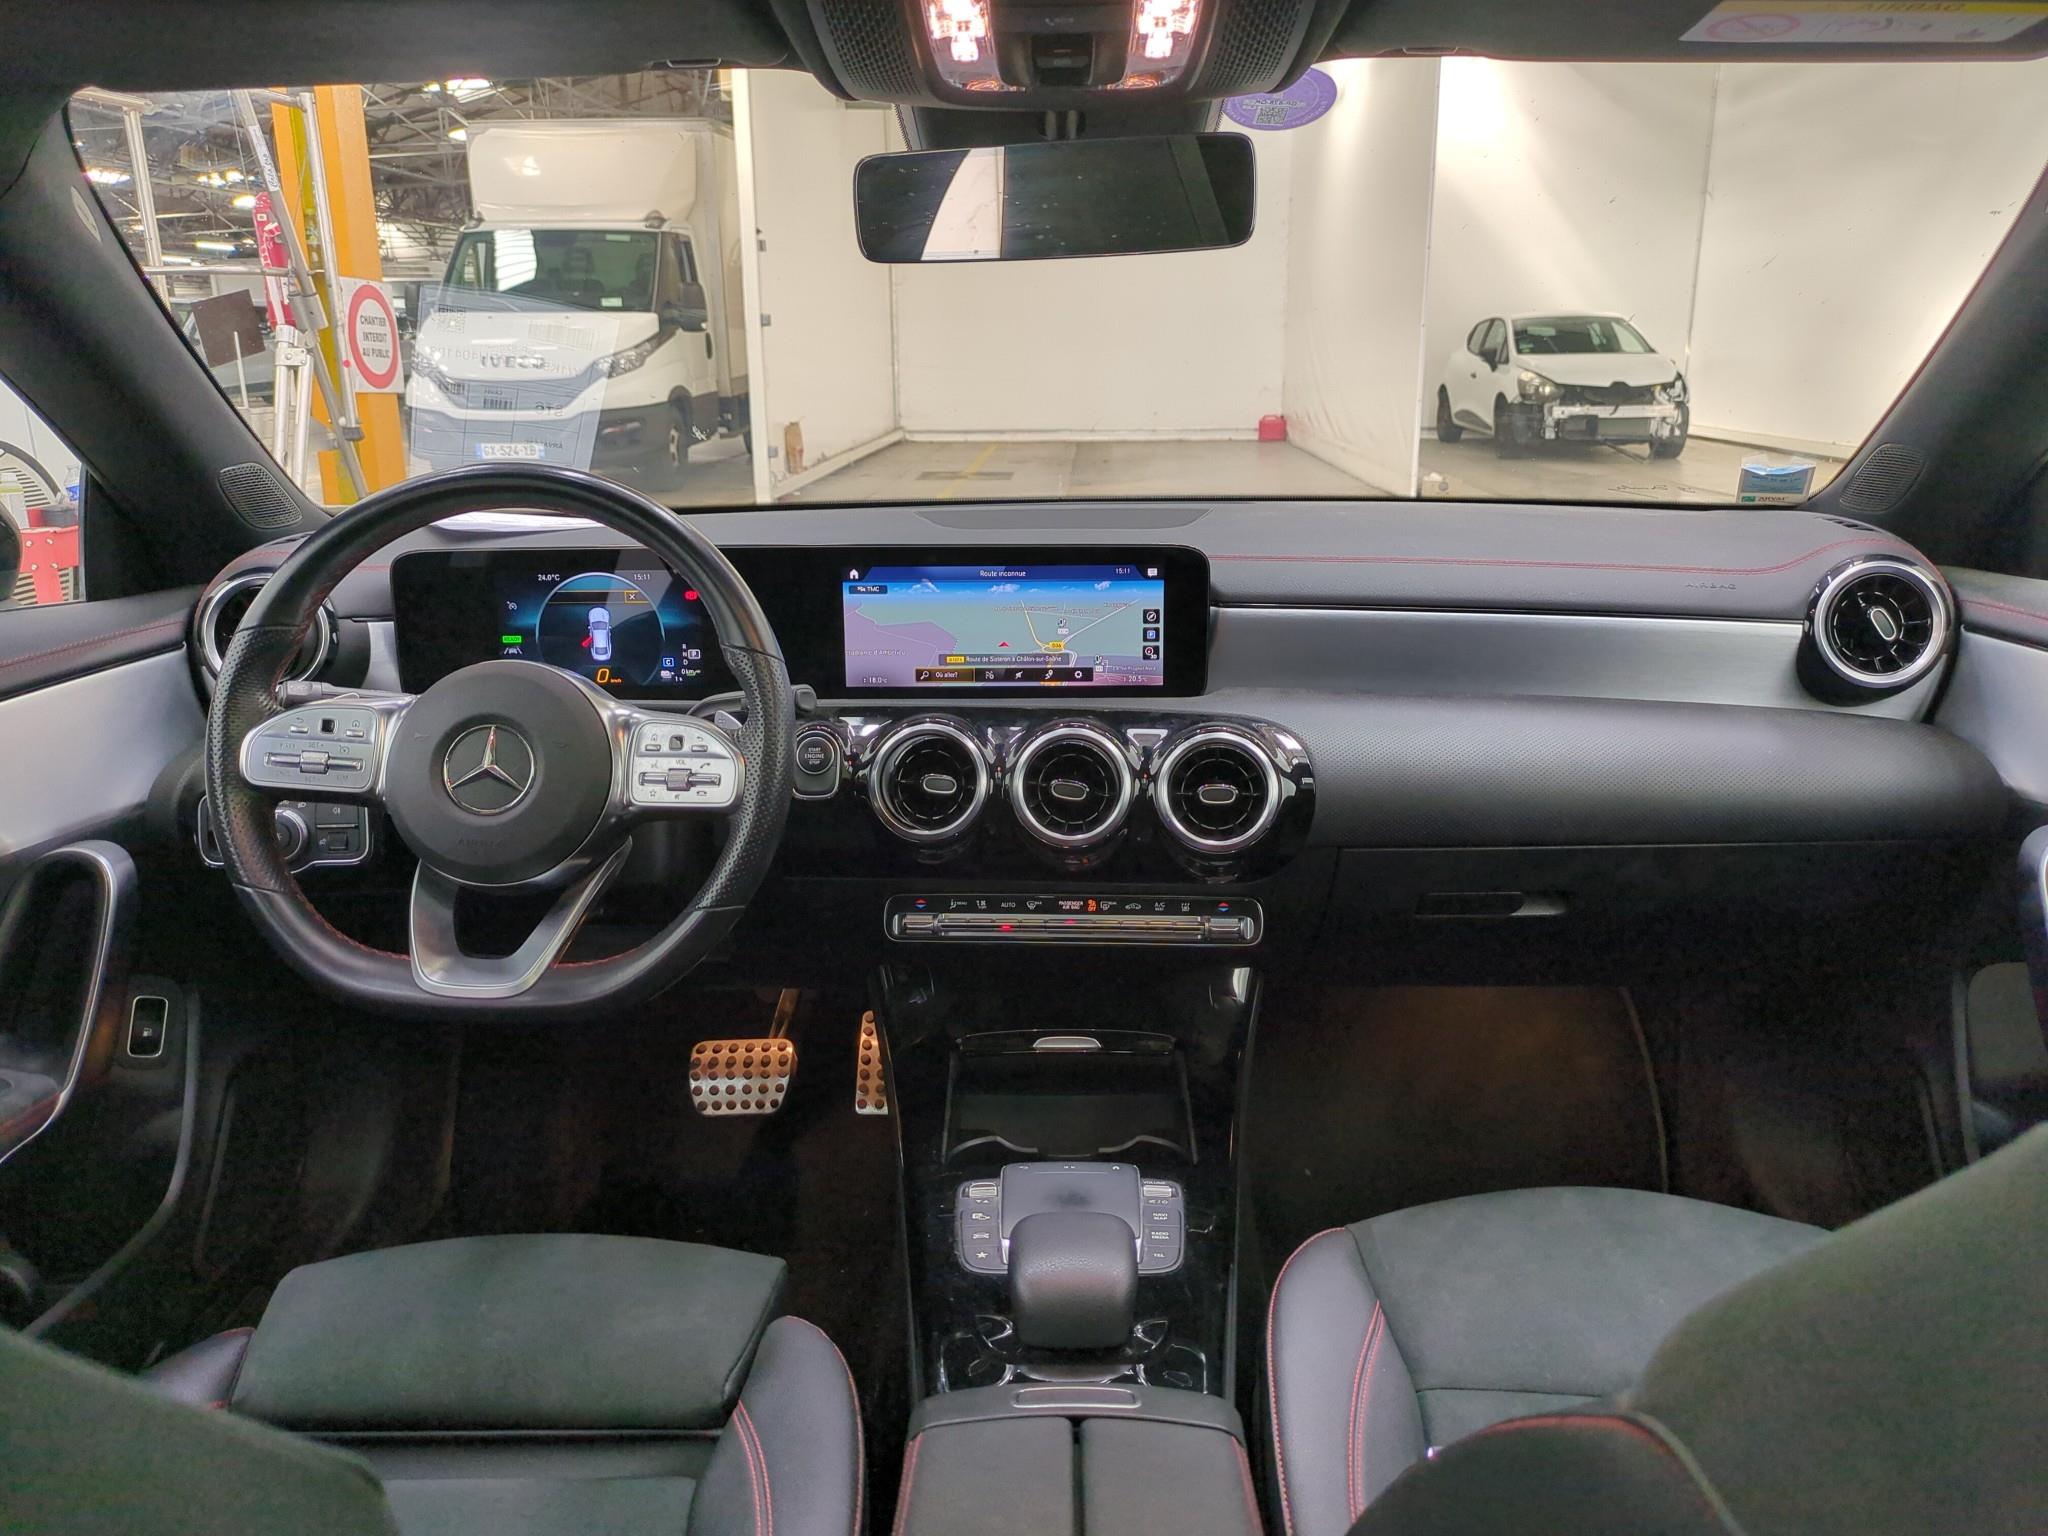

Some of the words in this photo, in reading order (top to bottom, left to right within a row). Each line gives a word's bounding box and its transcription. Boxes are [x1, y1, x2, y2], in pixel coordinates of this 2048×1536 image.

[360, 315, 387, 328] CHANTIER
[363, 332, 388, 343] INTERDIT
[362, 348, 371, 358] AU
[372, 348, 391, 359] PUBLIC
[481, 355, 544, 369] IVECO
[596, 668, 609, 683] 0
